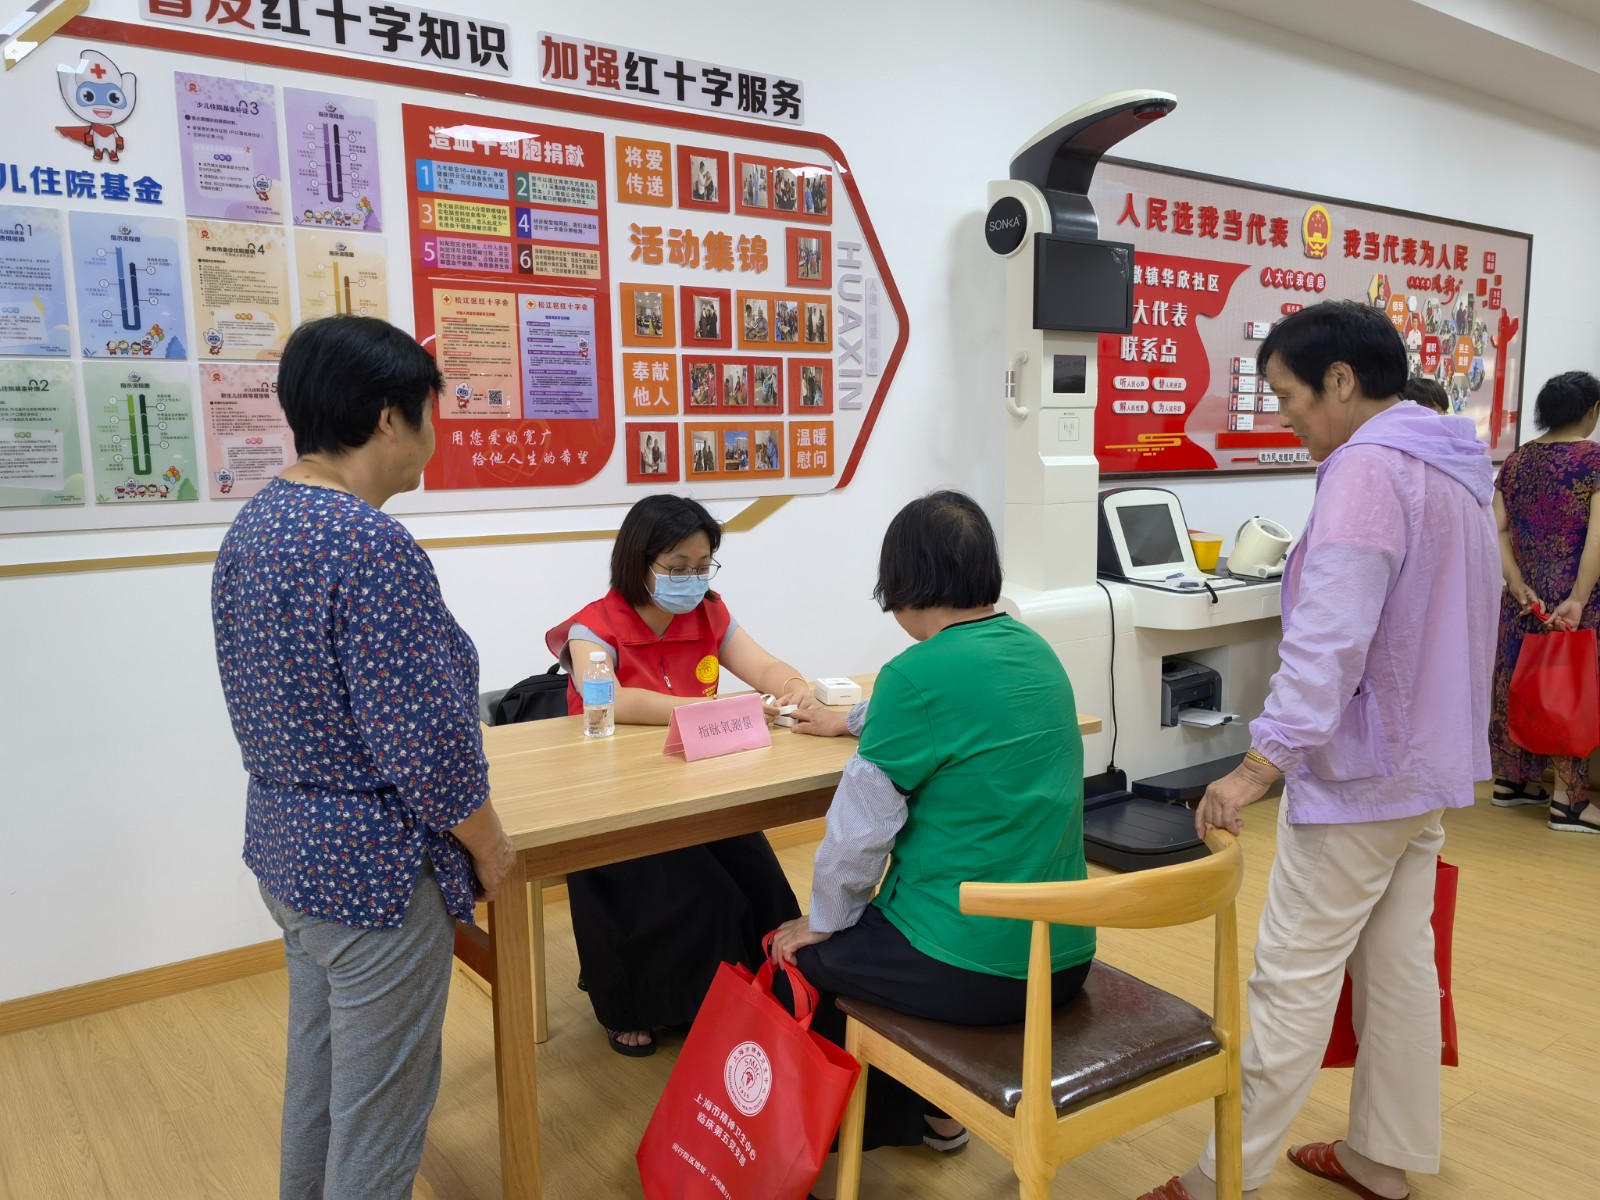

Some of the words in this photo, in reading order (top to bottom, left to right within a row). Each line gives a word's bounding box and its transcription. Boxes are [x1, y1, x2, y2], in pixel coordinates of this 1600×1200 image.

[541, 35, 801, 120] 加强红十字服务
[624, 145, 663, 172] 将爱
[421, 165, 429, 186] 1
[625, 172, 664, 198] 传递
[516, 176, 528, 197] 2
[422, 204, 433, 224] 3
[518, 213, 530, 233] 4
[989, 216, 1020, 231] SONKA
[1117, 192, 1289, 248] 人民选我当代表
[110, 234, 141, 243] 指示流程图
[630, 222, 769, 273] 活动集锦
[424, 241, 435, 261] 5
[520, 249, 531, 269] 6
[1343, 229, 1469, 271] 我当代表为人民
[1264, 268, 1325, 289] 人大代表信息
[455, 296, 509, 307] 松江区红十字会
[538, 301, 588, 311] 松江区红十字会
[1133, 299, 1188, 328] 大代表
[837, 240, 863, 410] HUAXIN
[1120, 336, 1177, 363] 联系点
[632, 361, 669, 383] 奉献
[633, 386, 670, 407] 他人
[452, 429, 552, 446] 用您爱的宽广
[796, 428, 827, 447] 温暖
[472, 448, 589, 467] 给他人生的希望
[796, 451, 827, 469] 慰问
[698, 715, 754, 738] 指脉氧测量
[693, 1093, 757, 1161] 上海市精神卫生中心
[696, 1111, 747, 1167] 临床第五党支部
